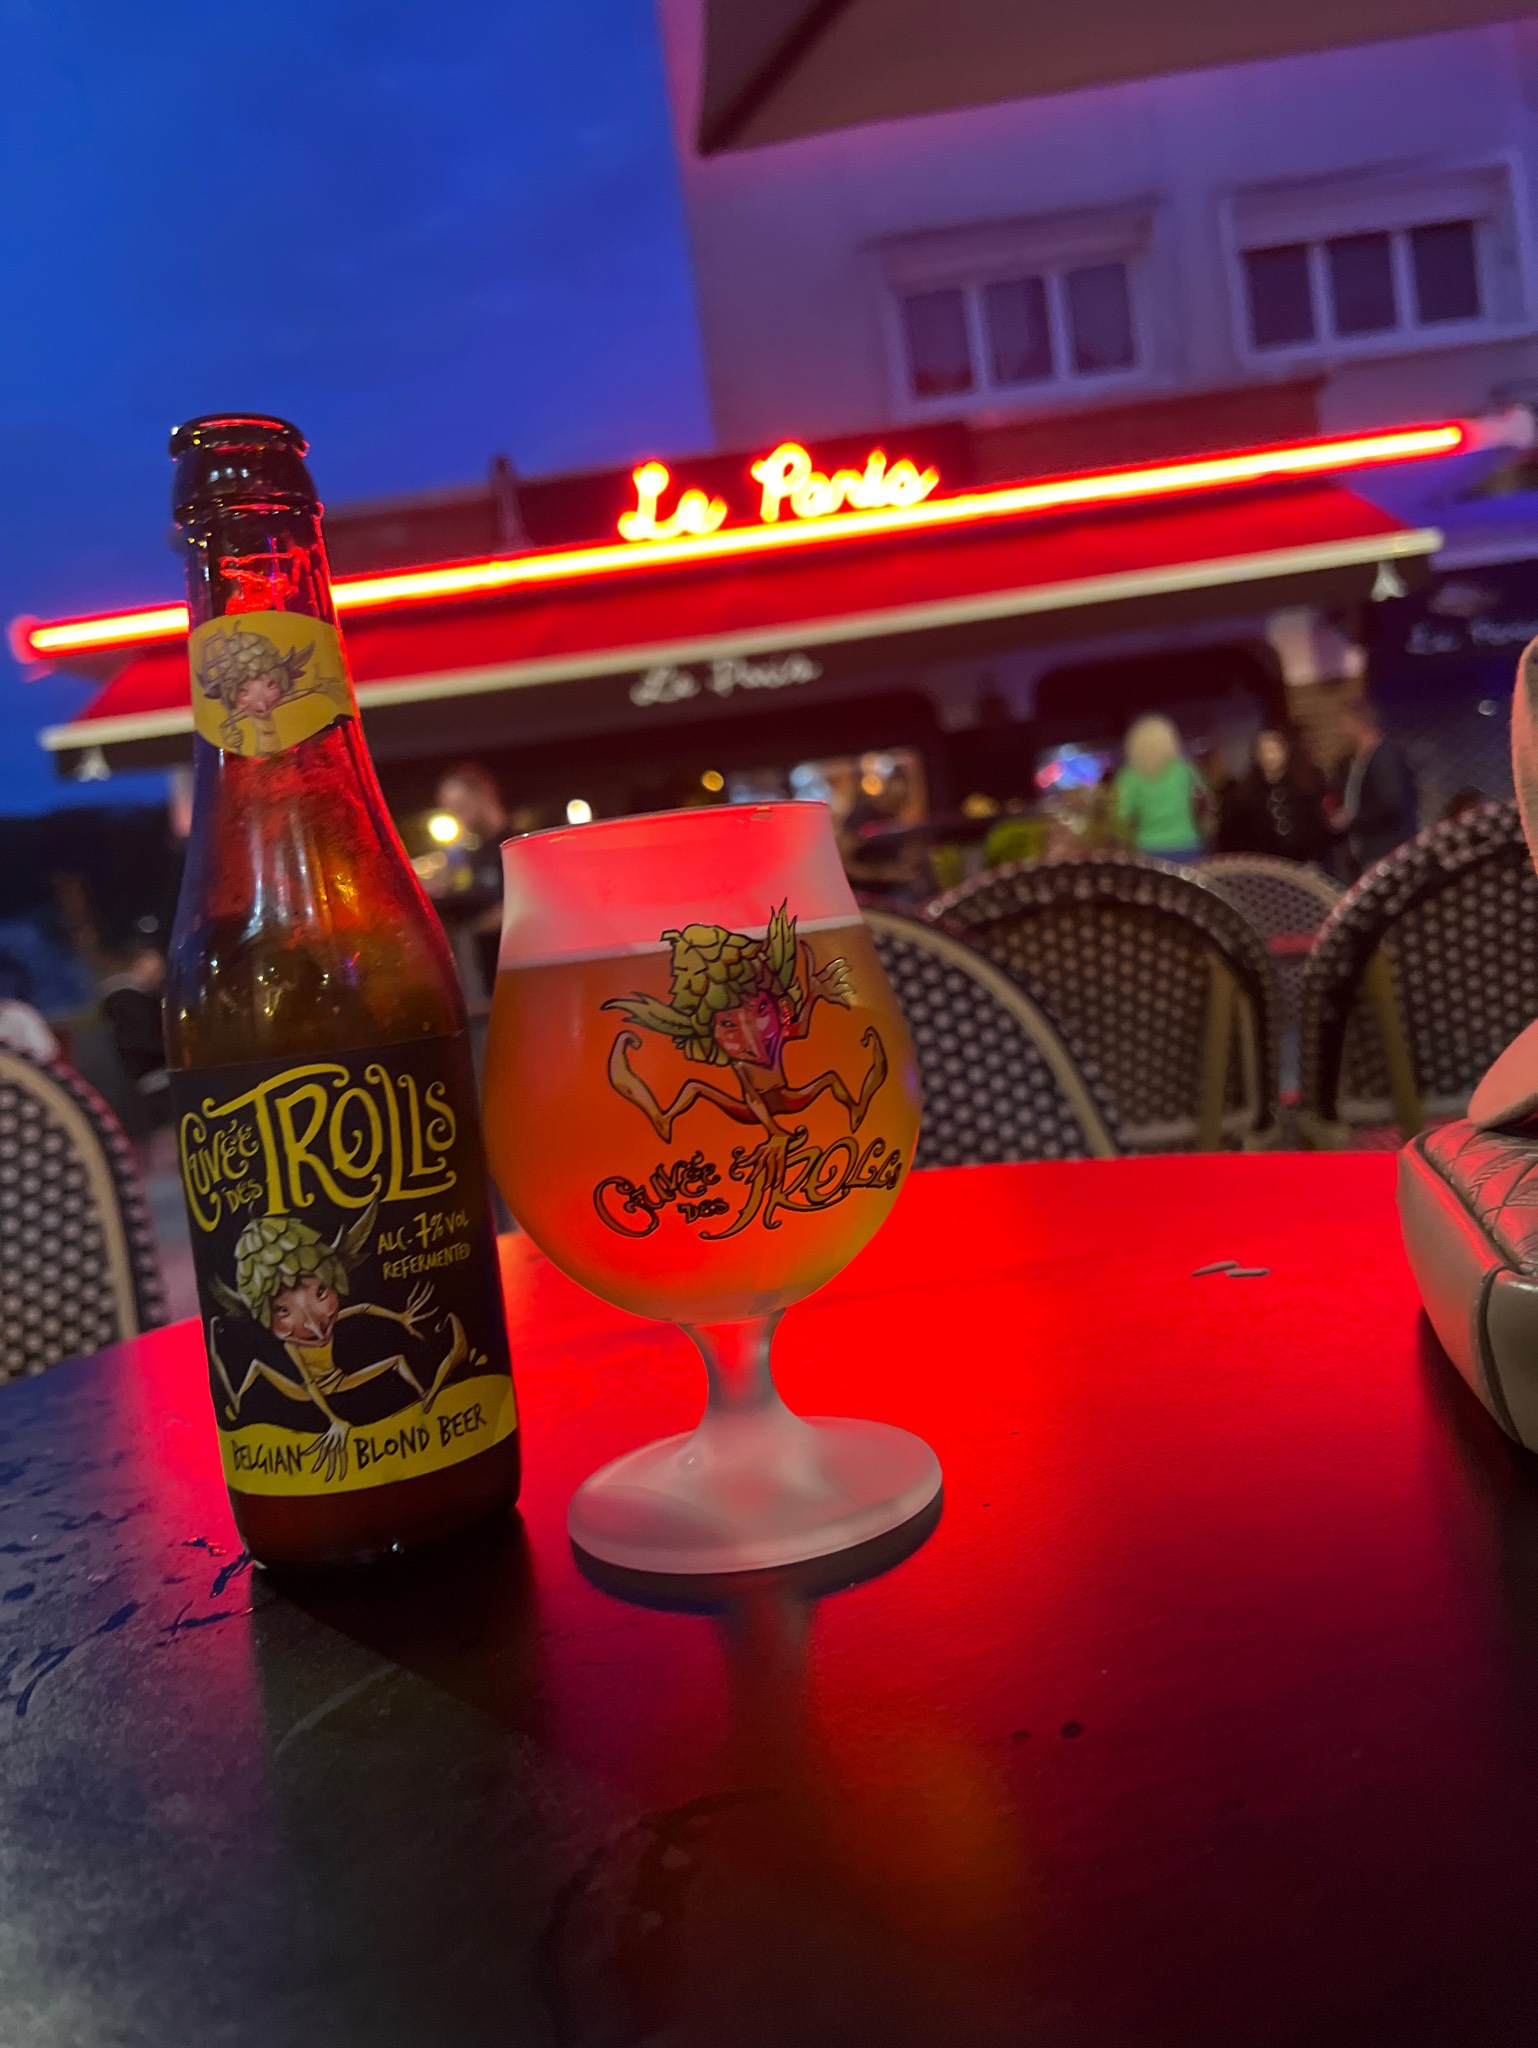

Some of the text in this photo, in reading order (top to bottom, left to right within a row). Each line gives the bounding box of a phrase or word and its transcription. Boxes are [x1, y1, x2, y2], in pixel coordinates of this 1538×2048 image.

[202, 1063, 457, 1216] TROLLS
[413, 1211, 445, 1249] 7%
[230, 1402, 488, 1476] BELGIAN BLOND BEER
